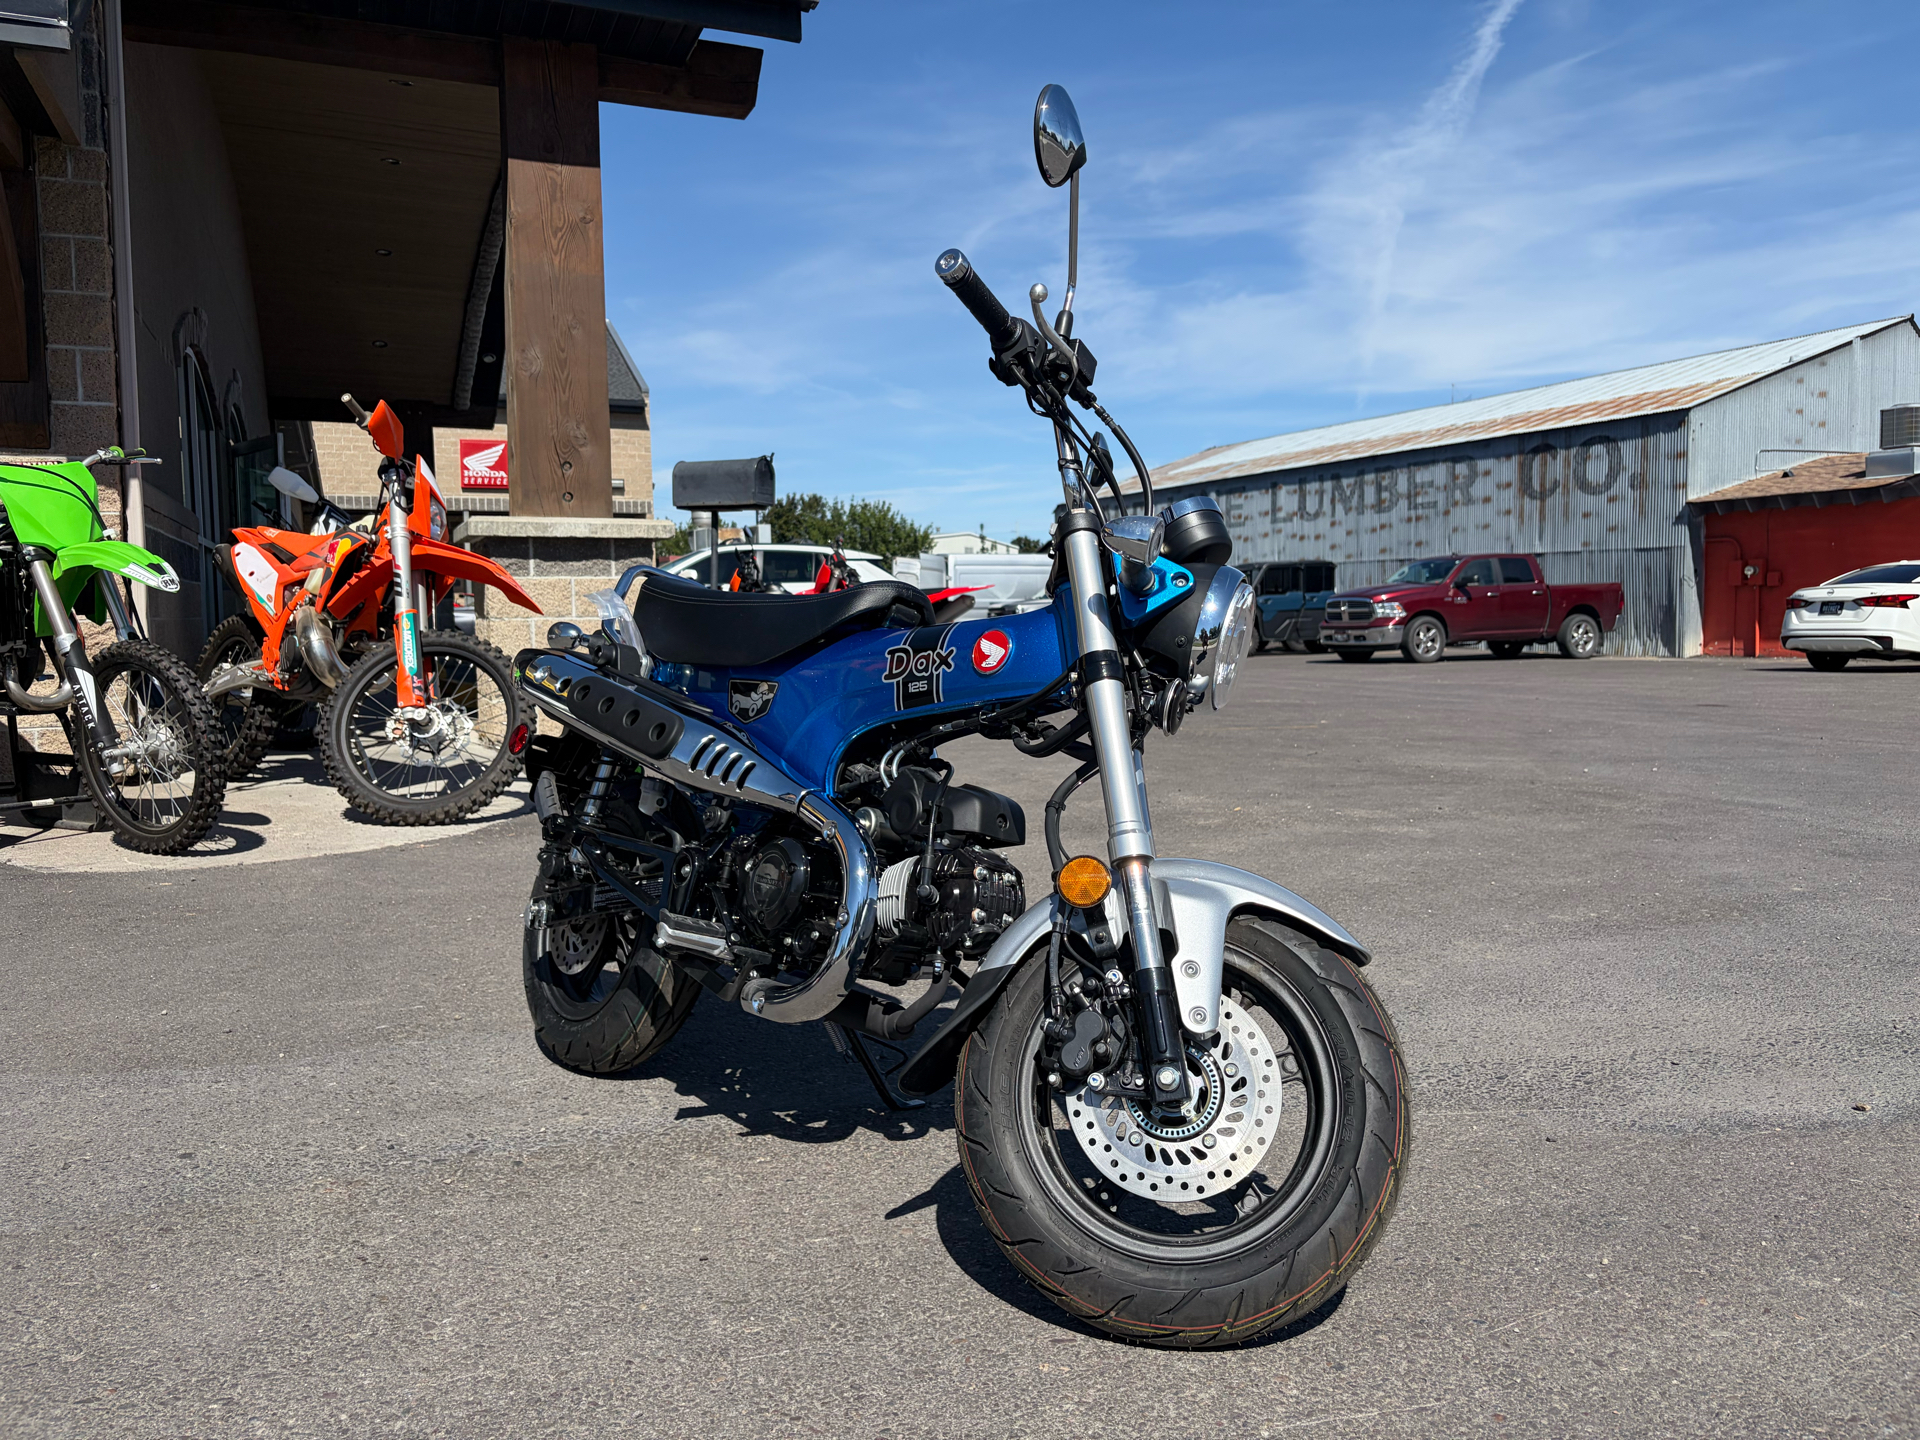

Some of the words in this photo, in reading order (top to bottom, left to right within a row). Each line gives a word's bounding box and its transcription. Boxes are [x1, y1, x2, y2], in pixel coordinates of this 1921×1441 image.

[463, 470, 508, 478] HONDA
[463, 477, 508, 485] SERVICE
[1269, 455, 1479, 524] LUMBER
[1521, 435, 1643, 501] CO.
[403, 631, 415, 668] MOTOREX
[882, 645, 957, 683] Dax
[907, 681, 928, 693] 125
[73, 684, 96, 729] ATTACK
